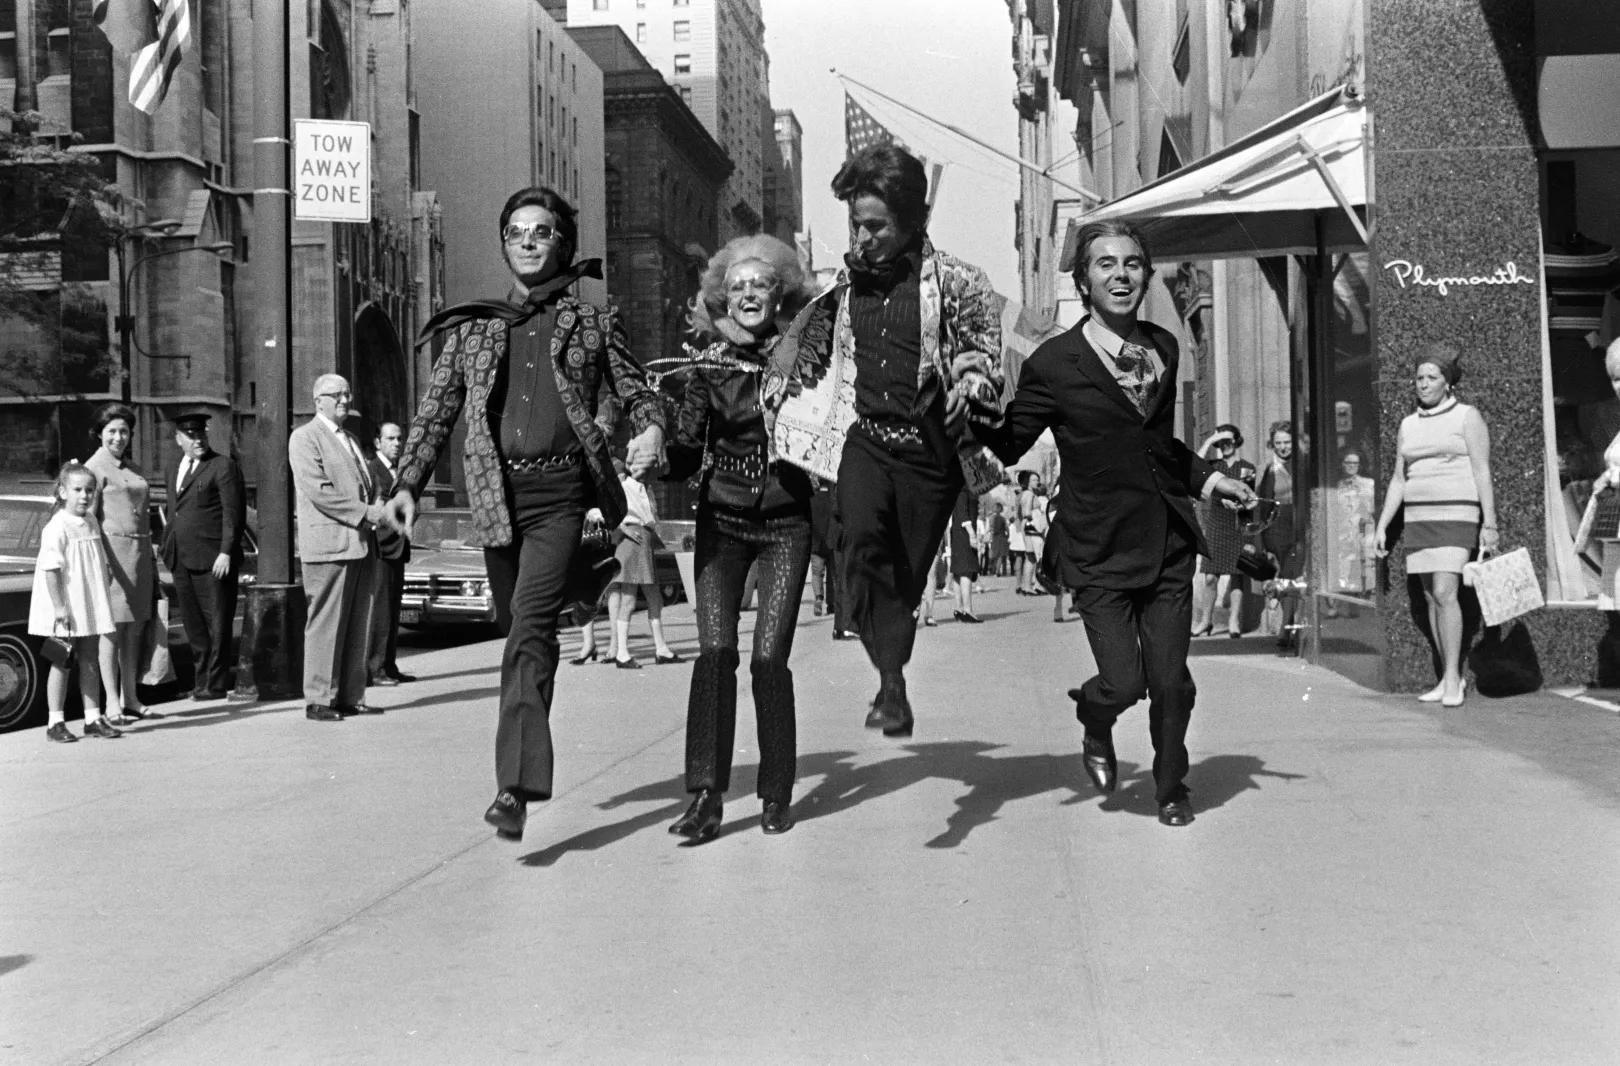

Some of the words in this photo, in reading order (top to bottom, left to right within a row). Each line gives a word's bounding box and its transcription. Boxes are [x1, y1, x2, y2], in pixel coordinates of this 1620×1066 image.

[310, 134, 353, 153] TOW
[300, 158, 361, 178] AWAY
[301, 183, 361, 204] ZONE
[1384, 259, 1535, 297] Plymouth
